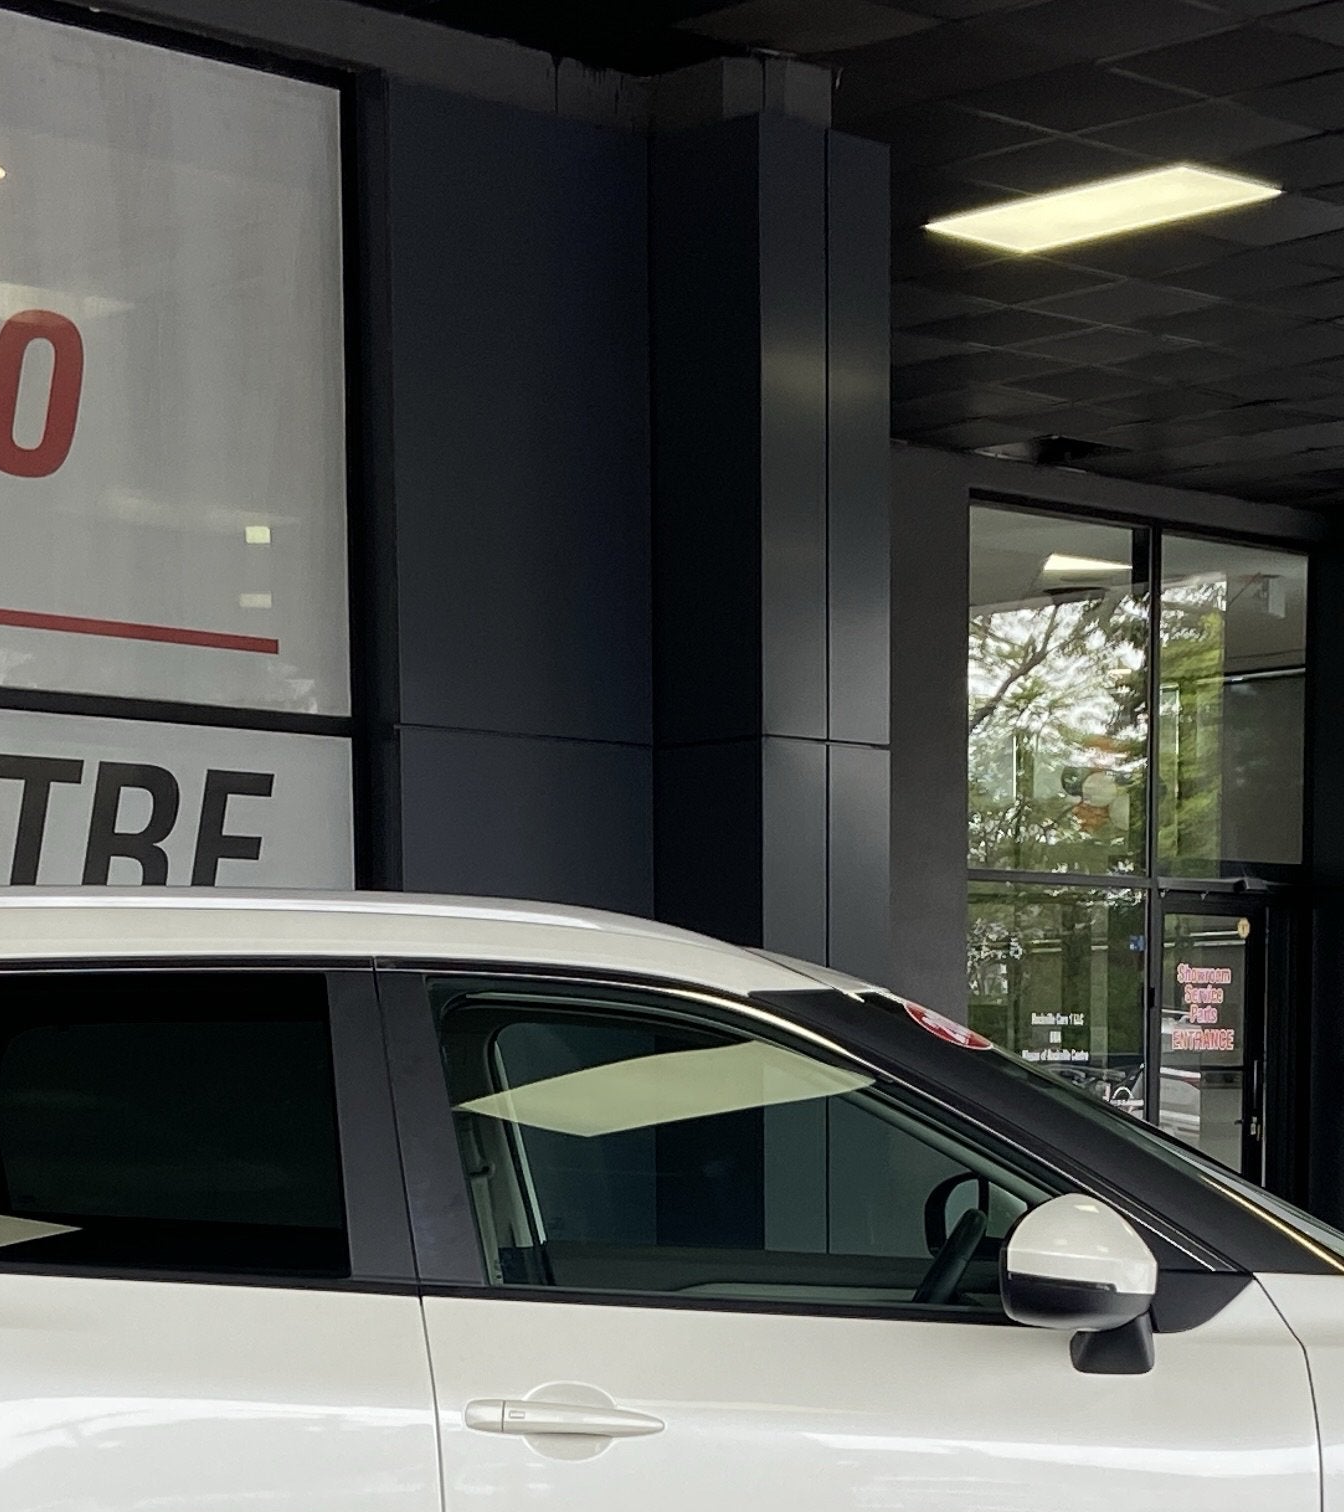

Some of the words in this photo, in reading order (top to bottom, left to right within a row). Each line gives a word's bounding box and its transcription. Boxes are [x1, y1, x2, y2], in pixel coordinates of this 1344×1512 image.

[1177, 963, 1232, 983] Showroom
[1184, 984, 1224, 1004] Service
[1190, 1004, 1218, 1024] Parts
[1171, 1028, 1235, 1051] ENTRANCE
